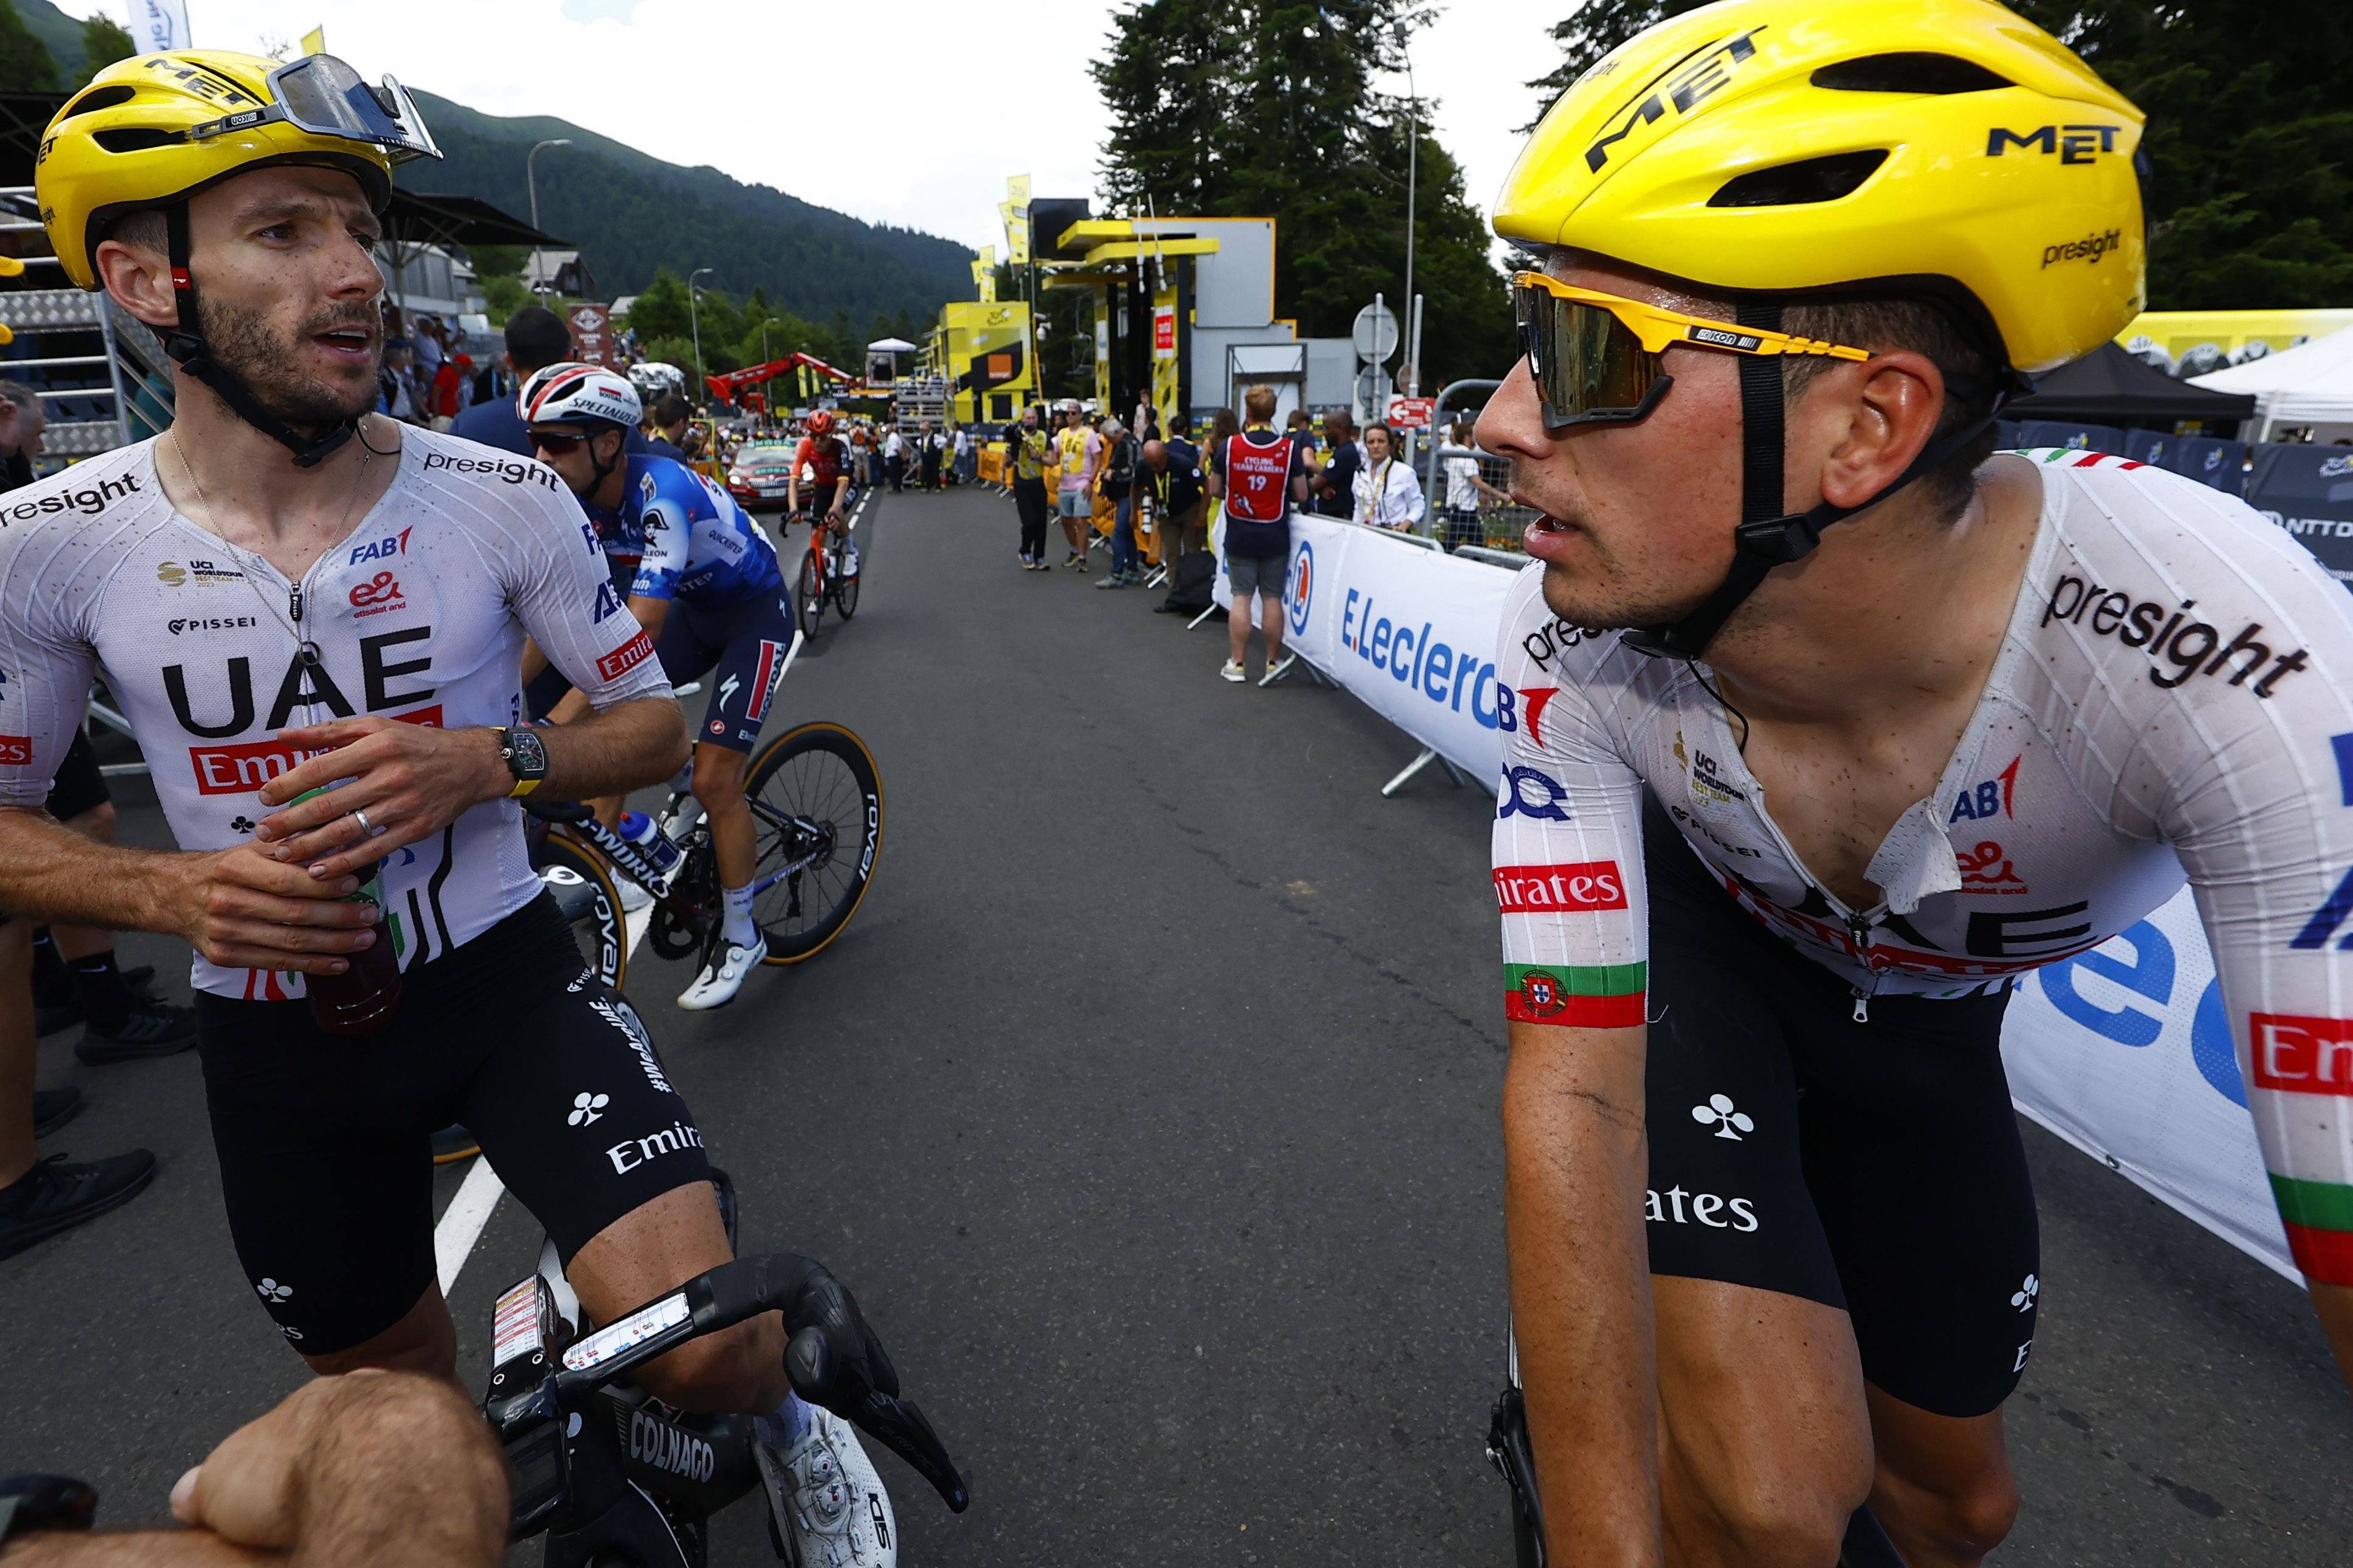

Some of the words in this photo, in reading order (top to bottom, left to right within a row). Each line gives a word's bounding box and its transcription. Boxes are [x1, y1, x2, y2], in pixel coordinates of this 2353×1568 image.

[144, 58, 258, 105] MET
[1585, 25, 1768, 174] MET
[38, 136, 59, 166] ET
[1987, 124, 2122, 165] MET
[2041, 228, 2122, 271] presight
[569, 397, 638, 425] SPECIALIZED
[423, 453, 560, 493] presight
[1247, 474, 1267, 491] 19
[0, 473, 141, 528] resight
[190, 560, 214, 570] UCI
[189, 616, 256, 632] PISSEI
[353, 607, 388, 619] etisalat
[388, 601, 407, 612] and
[604, 634, 653, 677] Emira
[2041, 572, 2312, 699] presight
[1342, 587, 1497, 730] E.Leclerc
[163, 626, 436, 739] UAE
[1693, 766, 1745, 802] WORLDTOUR
[1695, 749, 1717, 776] UCI
[1949, 780, 1999, 824] AB
[576, 818, 670, 899] S-WORKS
[1691, 818, 1762, 859] PISSEI
[605, 1121, 705, 1175] Emira
[630, 1410, 714, 1483] COLNAGO
